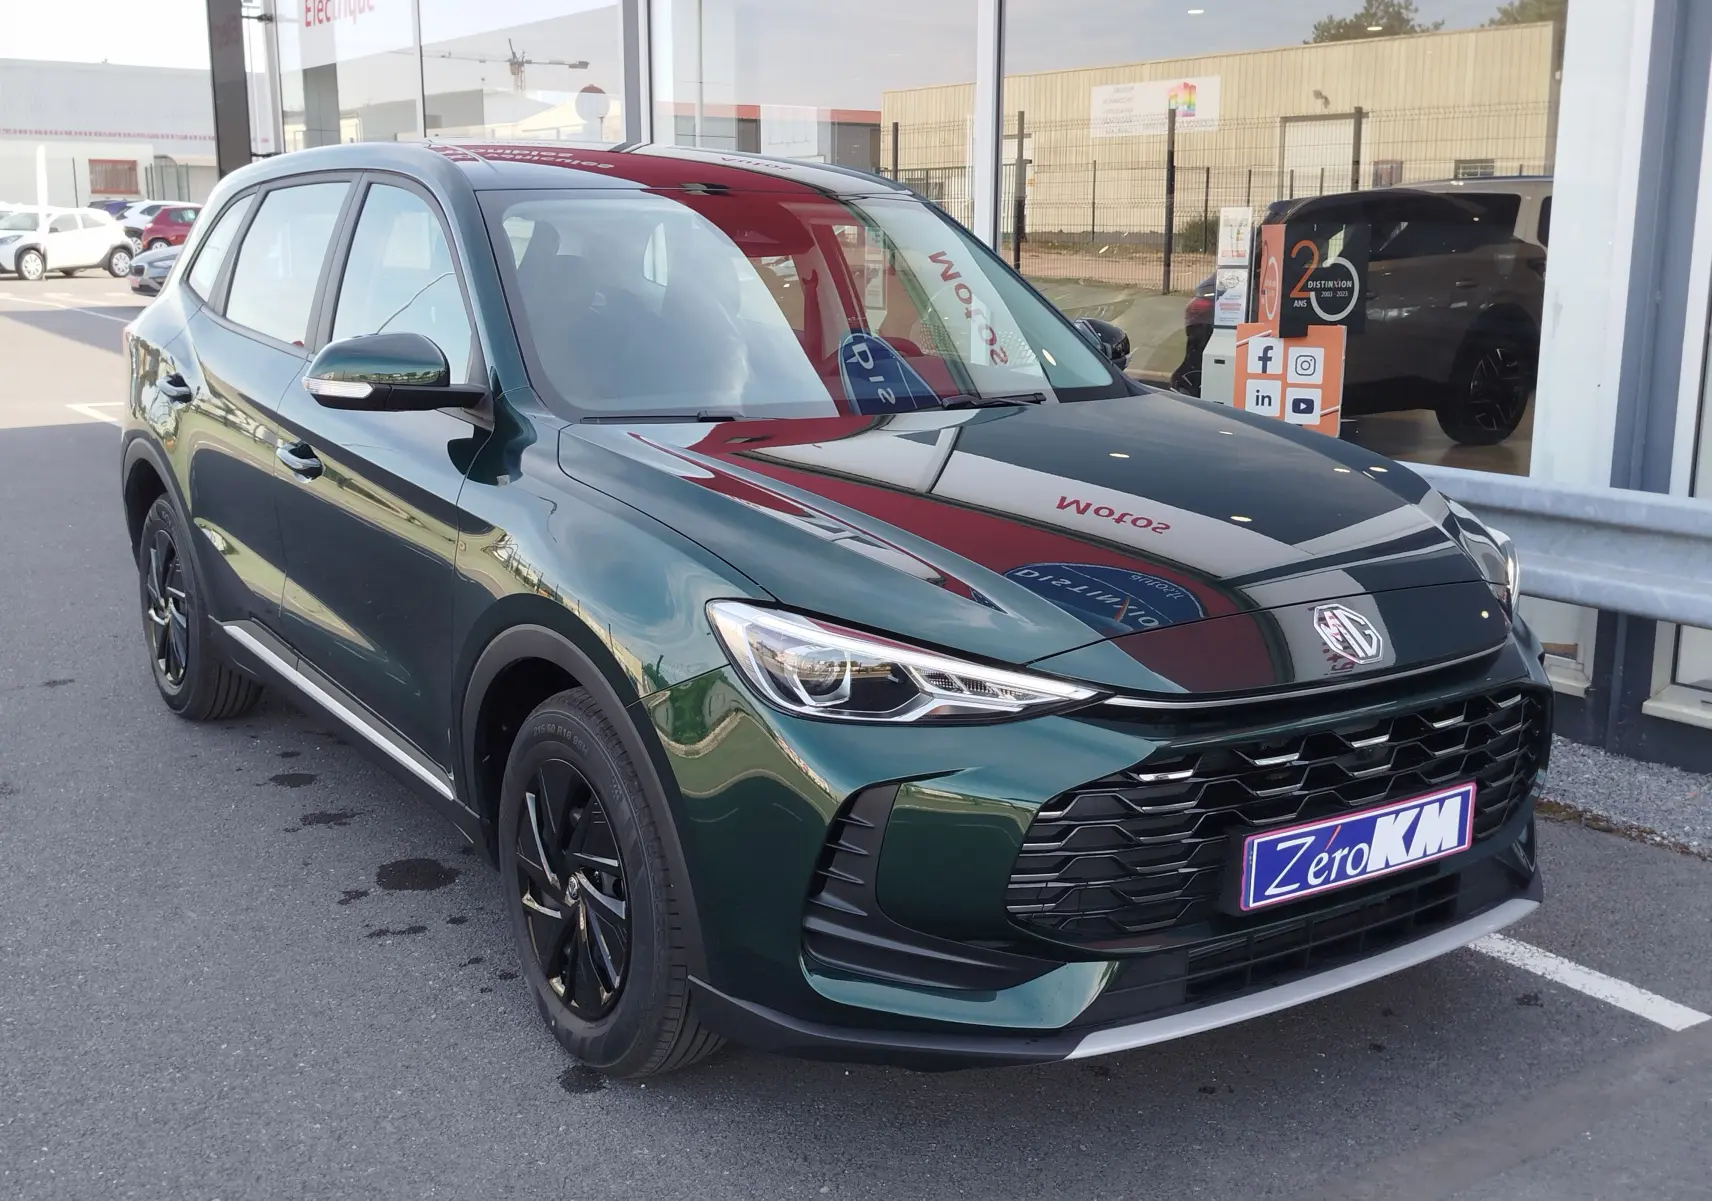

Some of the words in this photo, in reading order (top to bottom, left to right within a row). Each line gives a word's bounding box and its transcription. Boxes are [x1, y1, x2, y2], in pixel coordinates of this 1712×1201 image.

[1307, 280, 1352, 288] DISTINXION
[1293, 300, 1307, 308] ANS
[1255, 389, 1272, 407] in
[1320, 609, 1378, 658] MG
